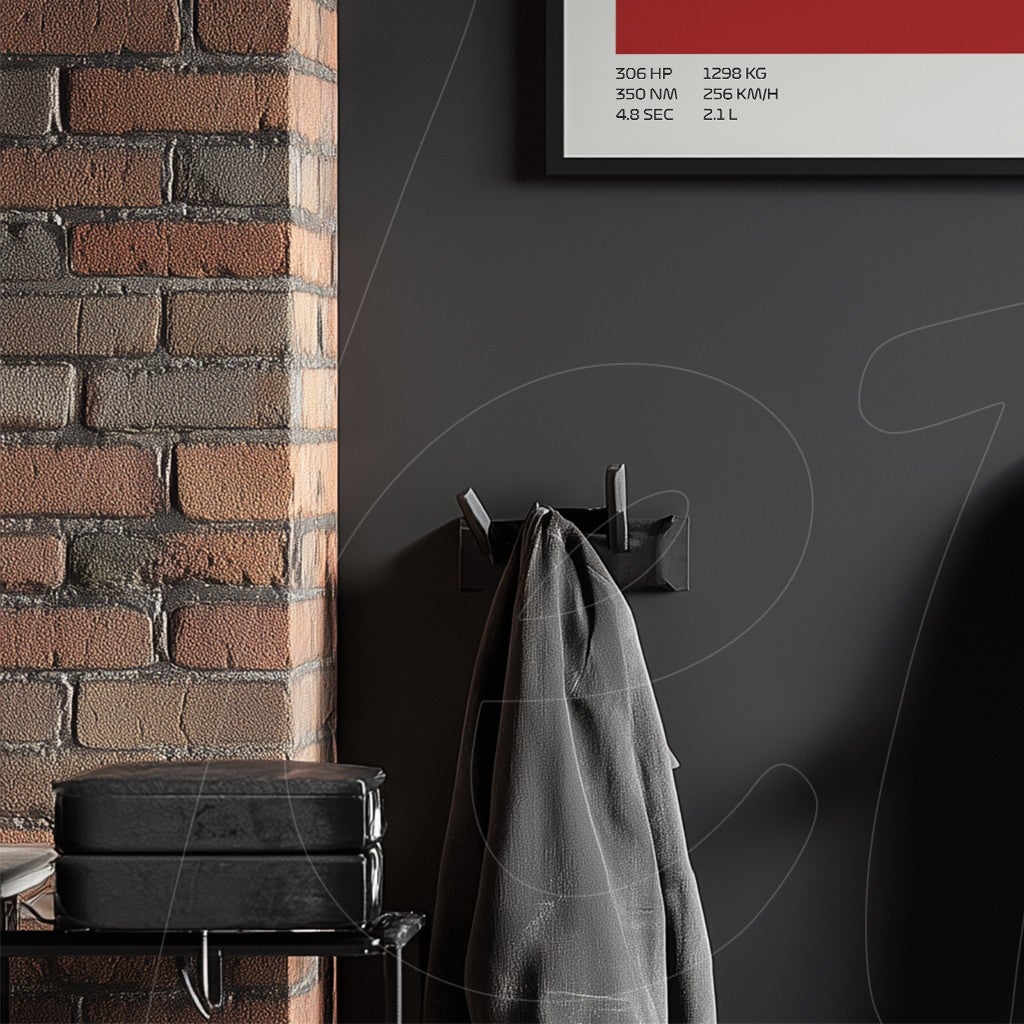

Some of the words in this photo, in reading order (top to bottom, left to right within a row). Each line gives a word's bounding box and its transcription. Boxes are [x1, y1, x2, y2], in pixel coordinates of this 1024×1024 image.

[615, 67, 647, 80] 306
[650, 67, 673, 80] HP
[703, 67, 742, 80] 1298
[745, 67, 767, 80] KG
[615, 88, 646, 100] 350
[650, 88, 678, 100] NM
[703, 88, 733, 100] 256
[736, 88, 779, 101] KM/H
[615, 108, 640, 121] 4.8
[643, 108, 674, 121] SEC
[703, 108, 725, 121] 2.1
[728, 108, 738, 121] L
